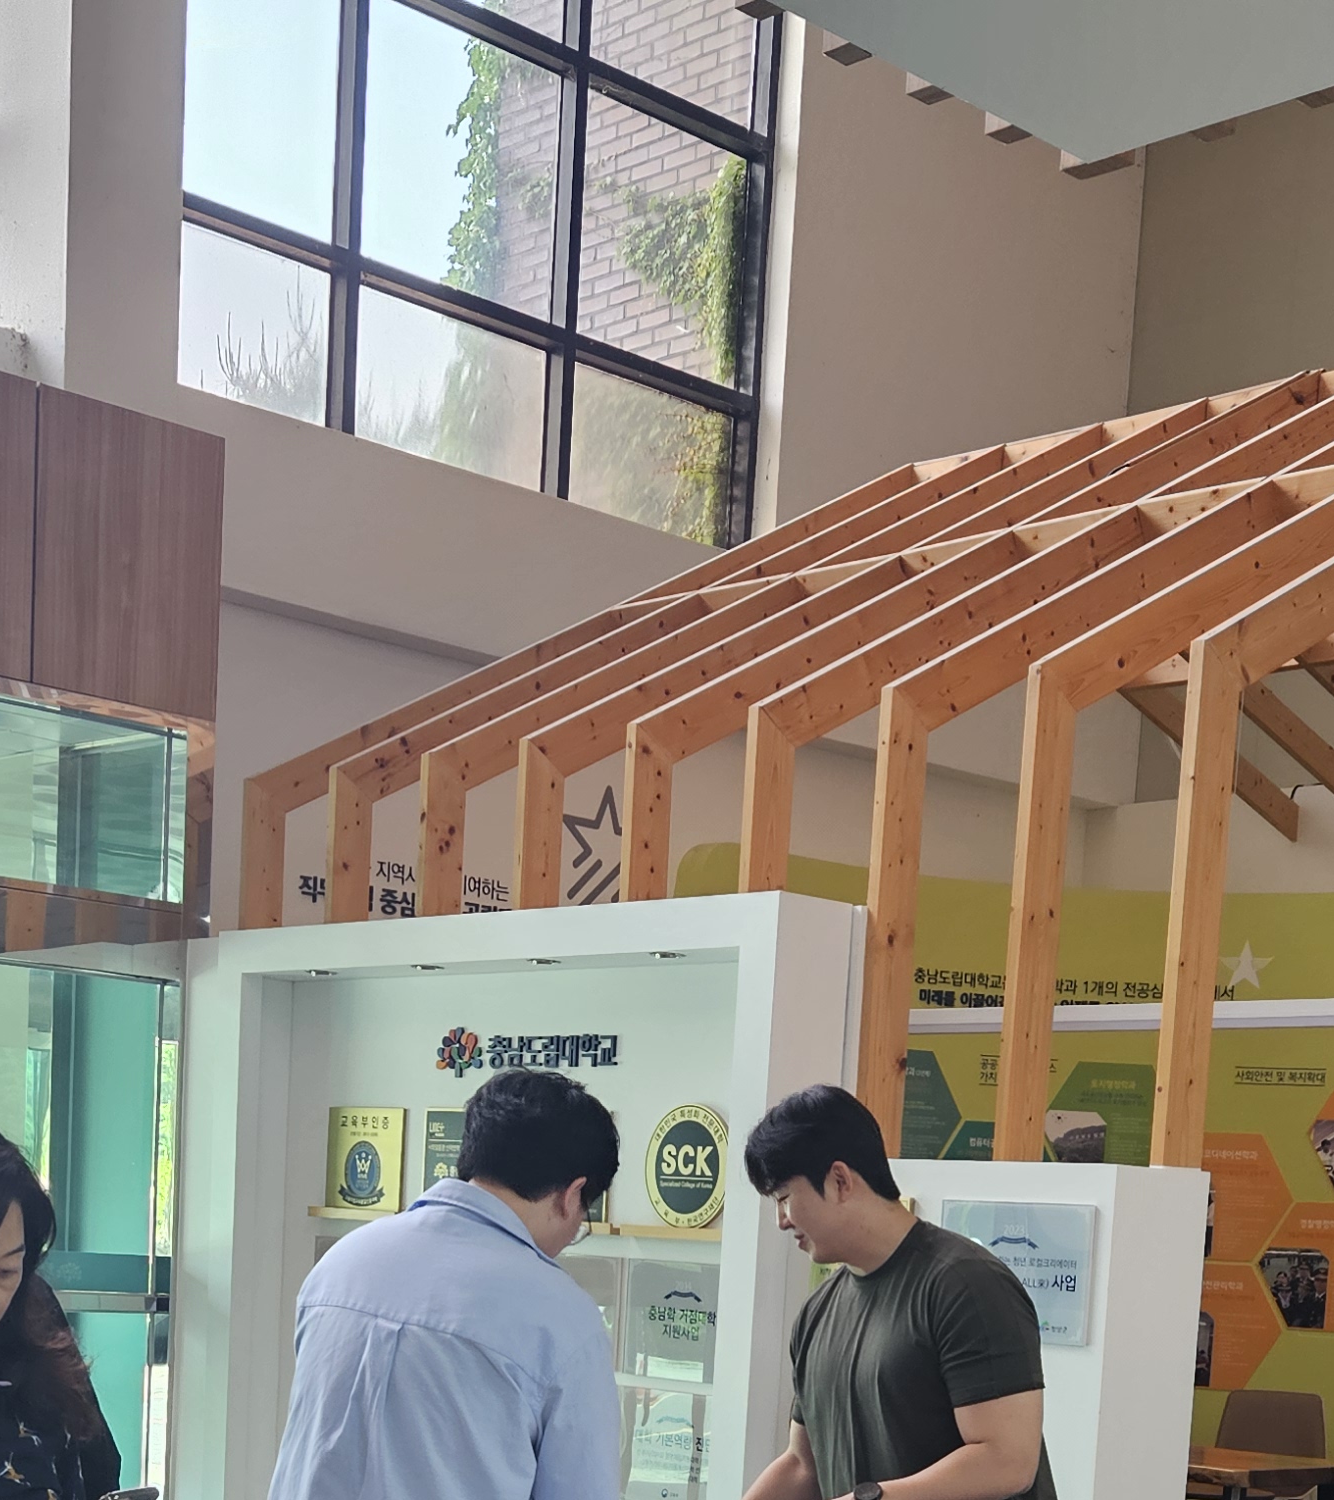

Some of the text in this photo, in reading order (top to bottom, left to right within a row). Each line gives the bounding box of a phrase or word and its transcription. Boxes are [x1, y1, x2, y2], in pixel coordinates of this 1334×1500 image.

[1083, 981, 1118, 997] 1개의
[486, 1034, 618, 1068] 충남도립대학교
[1235, 1071, 1326, 1083] 사회안전 및 복지확대
[655, 1109, 724, 1143] 대한민국 특성화 전문대학
[661, 1144, 713, 1176] SCK
[681, 1181, 695, 1189] College
[1003, 1224, 1025, 1234] 2023
[1028, 1257, 1077, 1269] 로컬크리에이터
[1051, 1274, 1077, 1292] 사업
[662, 1324, 700, 1341] 지원사업
